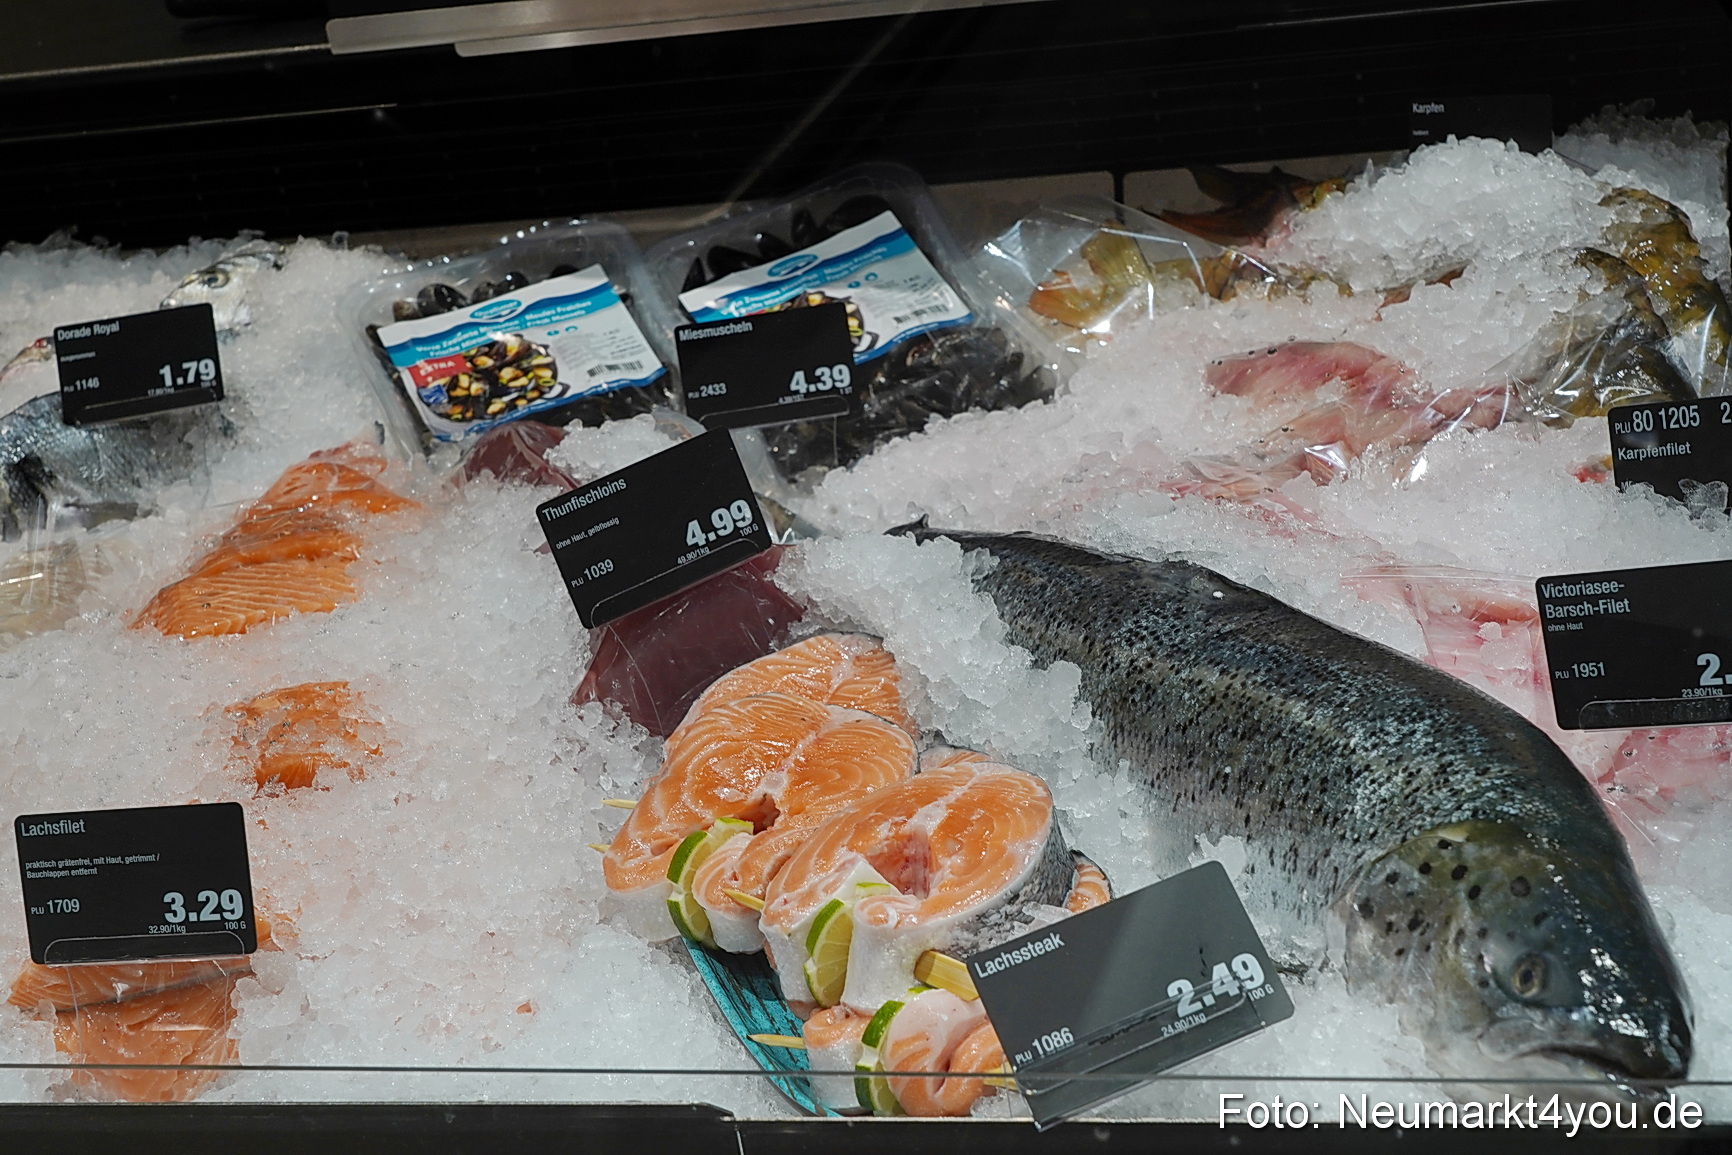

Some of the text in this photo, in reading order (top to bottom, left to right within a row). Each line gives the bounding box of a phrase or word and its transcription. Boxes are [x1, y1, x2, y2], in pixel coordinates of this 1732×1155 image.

[1412, 102, 1445, 115] Karpfen
[57, 320, 120, 342] Dorade Royal
[679, 321, 753, 342] Miesmuscheln
[159, 358, 217, 388] 1.79
[420, 360, 456, 377] EXTRA
[64, 377, 100, 393] PLU 1146
[789, 364, 852, 395] 4.39
[688, 382, 727, 399] PLU 2433
[1614, 421, 1631, 435] PLU
[1632, 409, 1655, 433] 80
[1658, 404, 1701, 431] 1205
[1618, 441, 1692, 462] Karpfenfilet
[542, 478, 627, 523] Thunfischloins
[556, 516, 620, 551] ohne Haut, gelbflossig
[685, 499, 753, 548] 4.99
[739, 526, 753, 538] 100
[677, 546, 710, 566] 49.90/1kg
[571, 558, 615, 588] PLU 1039
[1541, 580, 1626, 599] Victoriasee-
[1545, 598, 1631, 620] Barsch-Filet
[1548, 621, 1584, 632] ohne Haut
[1555, 661, 1606, 680] PLU 1951
[1681, 687, 1724, 698] 23.90/1kg
[21, 818, 86, 838] Lachsfilet
[25, 859, 57, 870] praktisch
[57, 856, 93, 869] grätenfrei,
[93, 855, 105, 866] mit
[105, 855, 124, 865] Haut,
[124, 853, 156, 866] getrimmt
[26, 866, 98, 880] Bauchlappen entfernt
[31, 898, 80, 916] PLU 1709
[163, 888, 244, 924] 3.29
[148, 924, 186, 935] 32.90/1kg
[224, 921, 247, 931] 100 G
[974, 931, 1066, 980] Lachssteak
[1166, 952, 1266, 1018] 2.49
[1248, 983, 1275, 1002] 100 G
[1161, 1012, 1208, 1037] 24.90/1kg
[1014, 1026, 1075, 1065] PLU 1086
